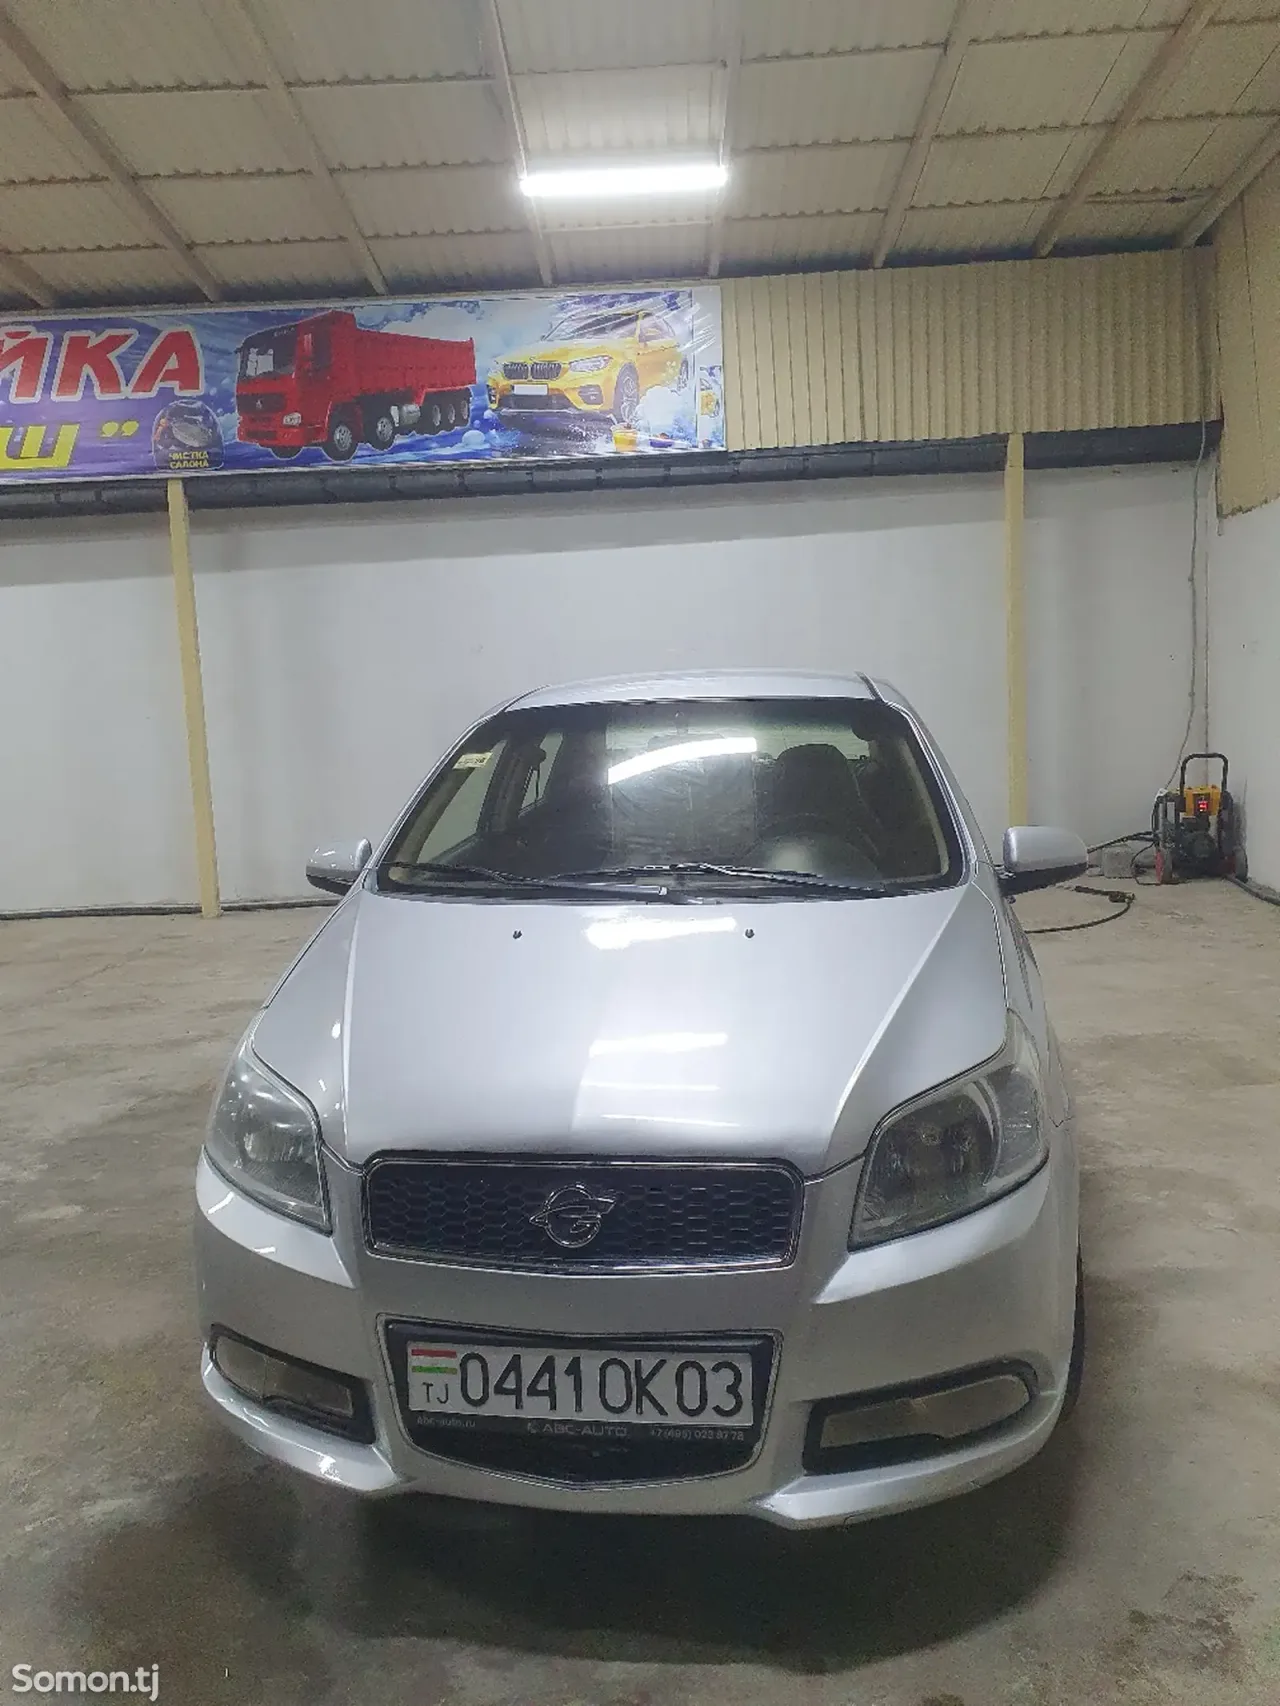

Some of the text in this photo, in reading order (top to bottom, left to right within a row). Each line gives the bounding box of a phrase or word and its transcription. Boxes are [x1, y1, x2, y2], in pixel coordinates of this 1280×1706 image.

[169, 451, 209, 460] ЧИСТКА
[170, 460, 209, 469] САЛОНА
[422, 1381, 449, 1404] TJ
[543, 1422, 627, 1437] ABC-AUTO
